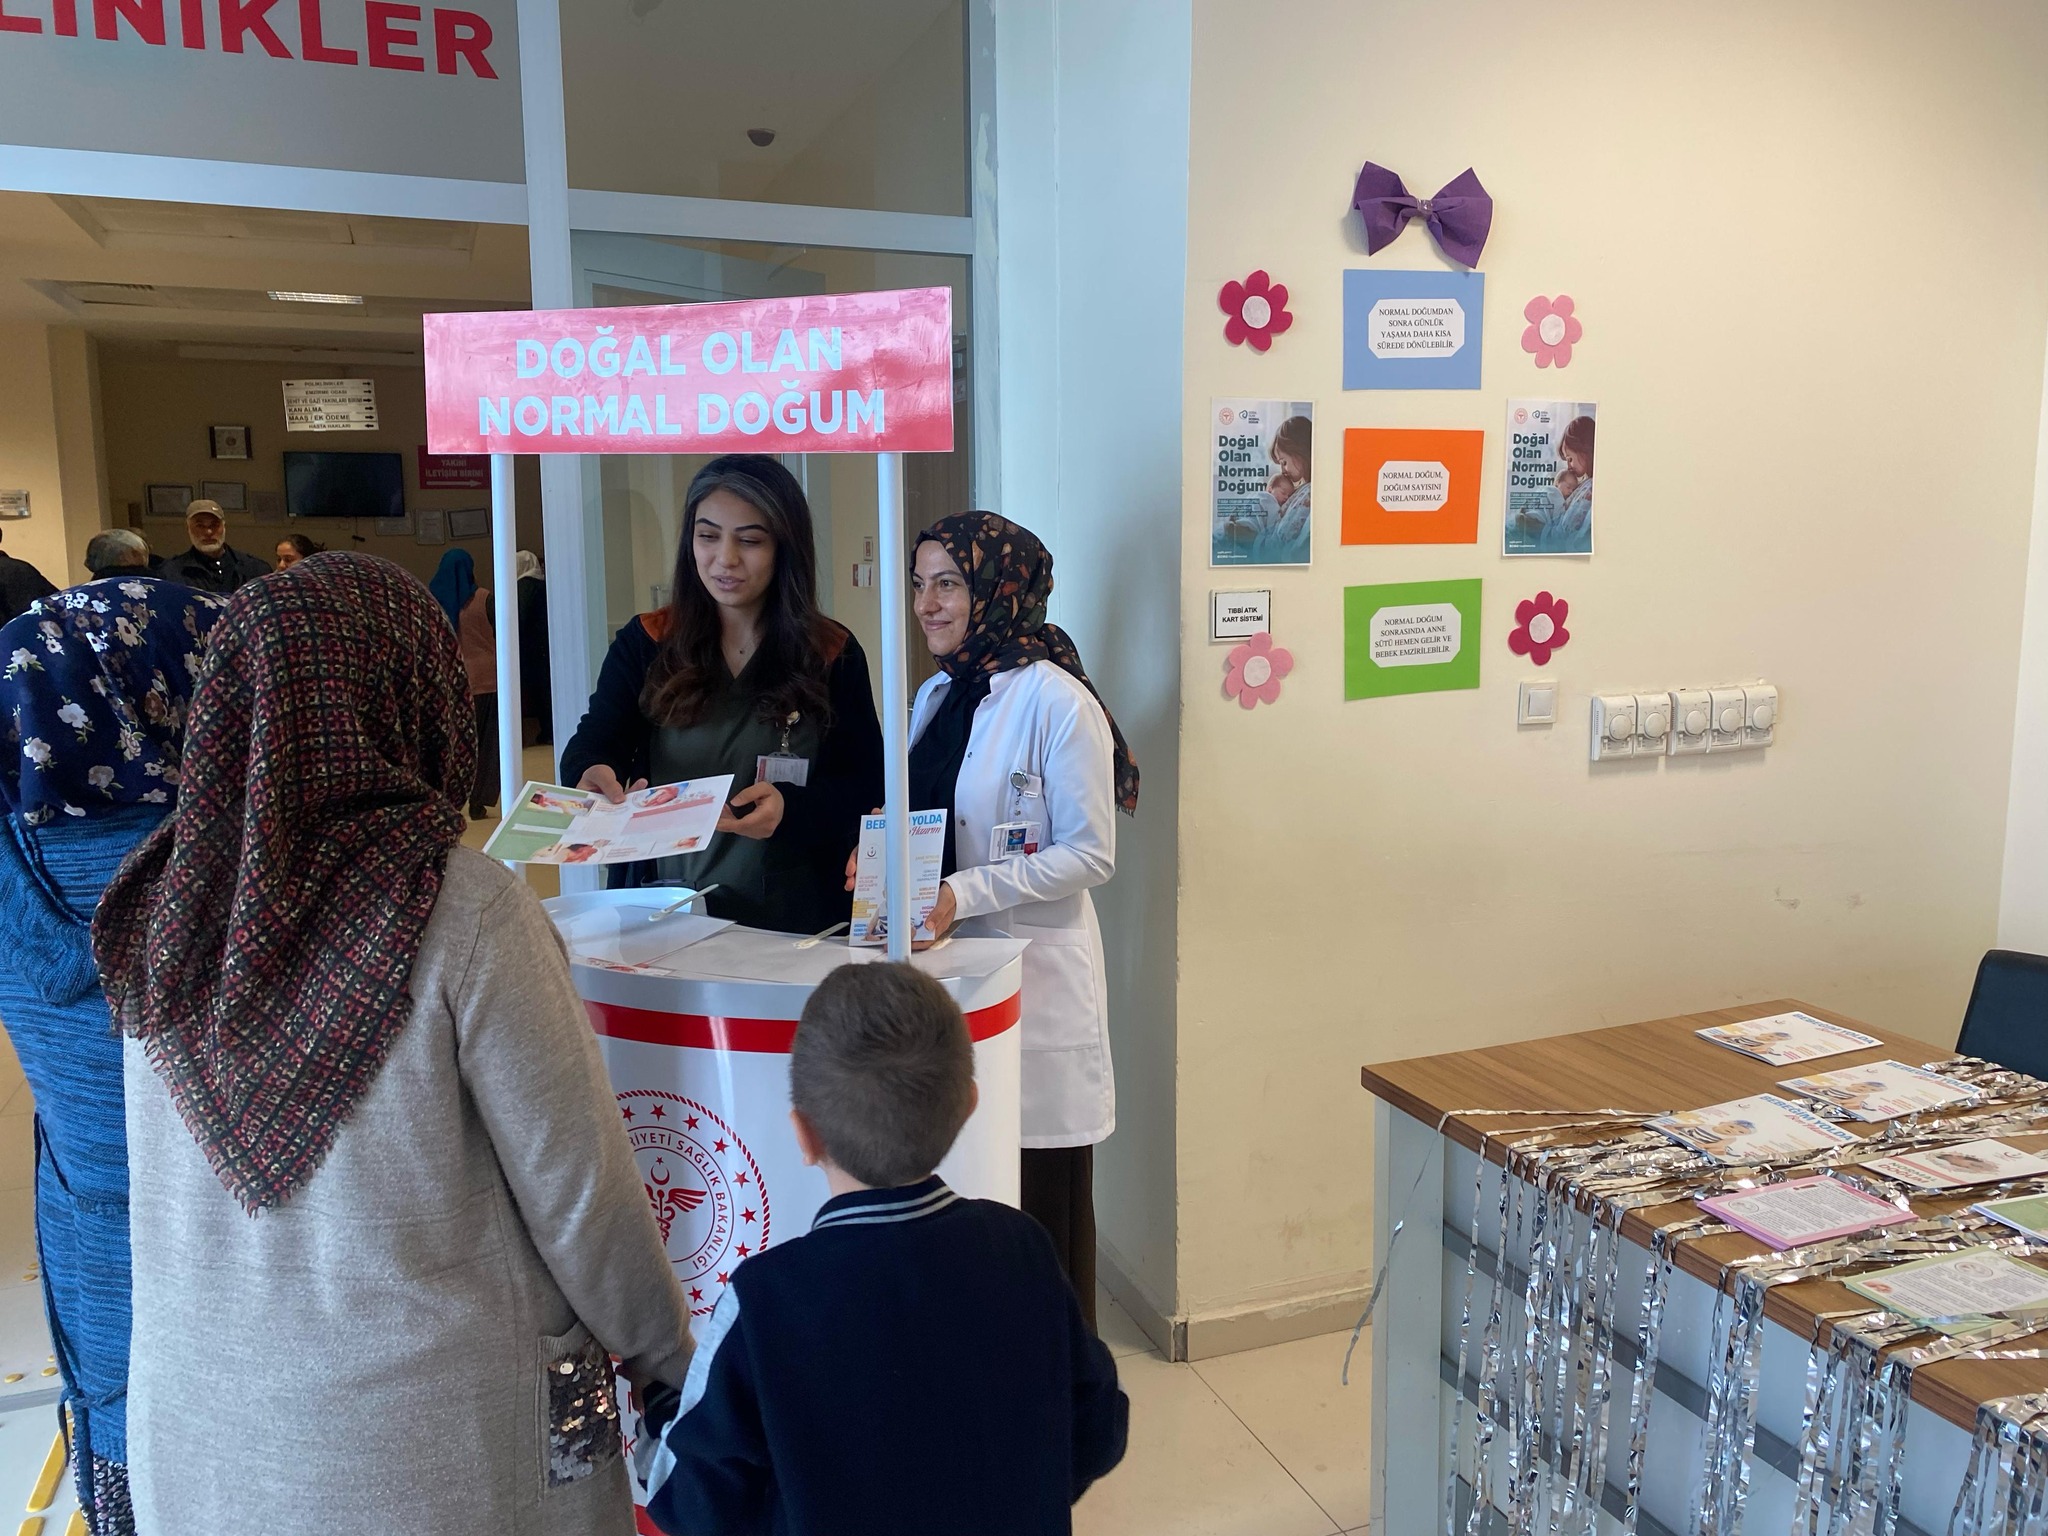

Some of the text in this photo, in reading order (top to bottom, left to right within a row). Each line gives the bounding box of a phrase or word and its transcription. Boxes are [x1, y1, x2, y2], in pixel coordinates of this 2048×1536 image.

[1379, 307, 1454, 316] NORMAL DOĞUMDAN
[1414, 318, 1444, 326] GÜNLÜK
[1381, 331, 1412, 339] YAŞAMA
[1377, 341, 1405, 349] SÜREDE
[516, 325, 842, 379] DOĞAL OLAN
[478, 379, 885, 436] NORMAL DOĞUM
[1218, 434, 1259, 450] Doğal
[1513, 433, 1549, 447] Doğal
[1218, 450, 1252, 462] Olan
[1512, 447, 1542, 459] Olan
[1218, 465, 1270, 477] Normal
[1511, 461, 1557, 473] Normal
[1382, 471, 1413, 479] NORMAL
[1217, 479, 1268, 495] Doğum
[1383, 483, 1410, 491] DOĞUM
[1511, 474, 1555, 489] Doğum
[1227, 606, 1243, 614] TIBBİ
[1239, 614, 1263, 622] SİSTEMİ
[1384, 615, 1443, 626] NORMAL DOĞUM
[1380, 625, 1446, 637] SONRASINDA ANNE
[1374, 639, 1393, 648] SÜTÜ
[1394, 638, 1420, 646] HEMEN
[1420, 635, 1441, 644] GELİR
[1375, 650, 1398, 658] BEBEK
[912, 814, 943, 826] YOLDA
[1814, 1119, 1853, 1141] YOLDA
[676, 1140, 721, 1187] SAĞLIK
[1888, 1162, 1937, 1181] NORMAL
[692, 1192, 728, 1270] BAKANLIĞI
